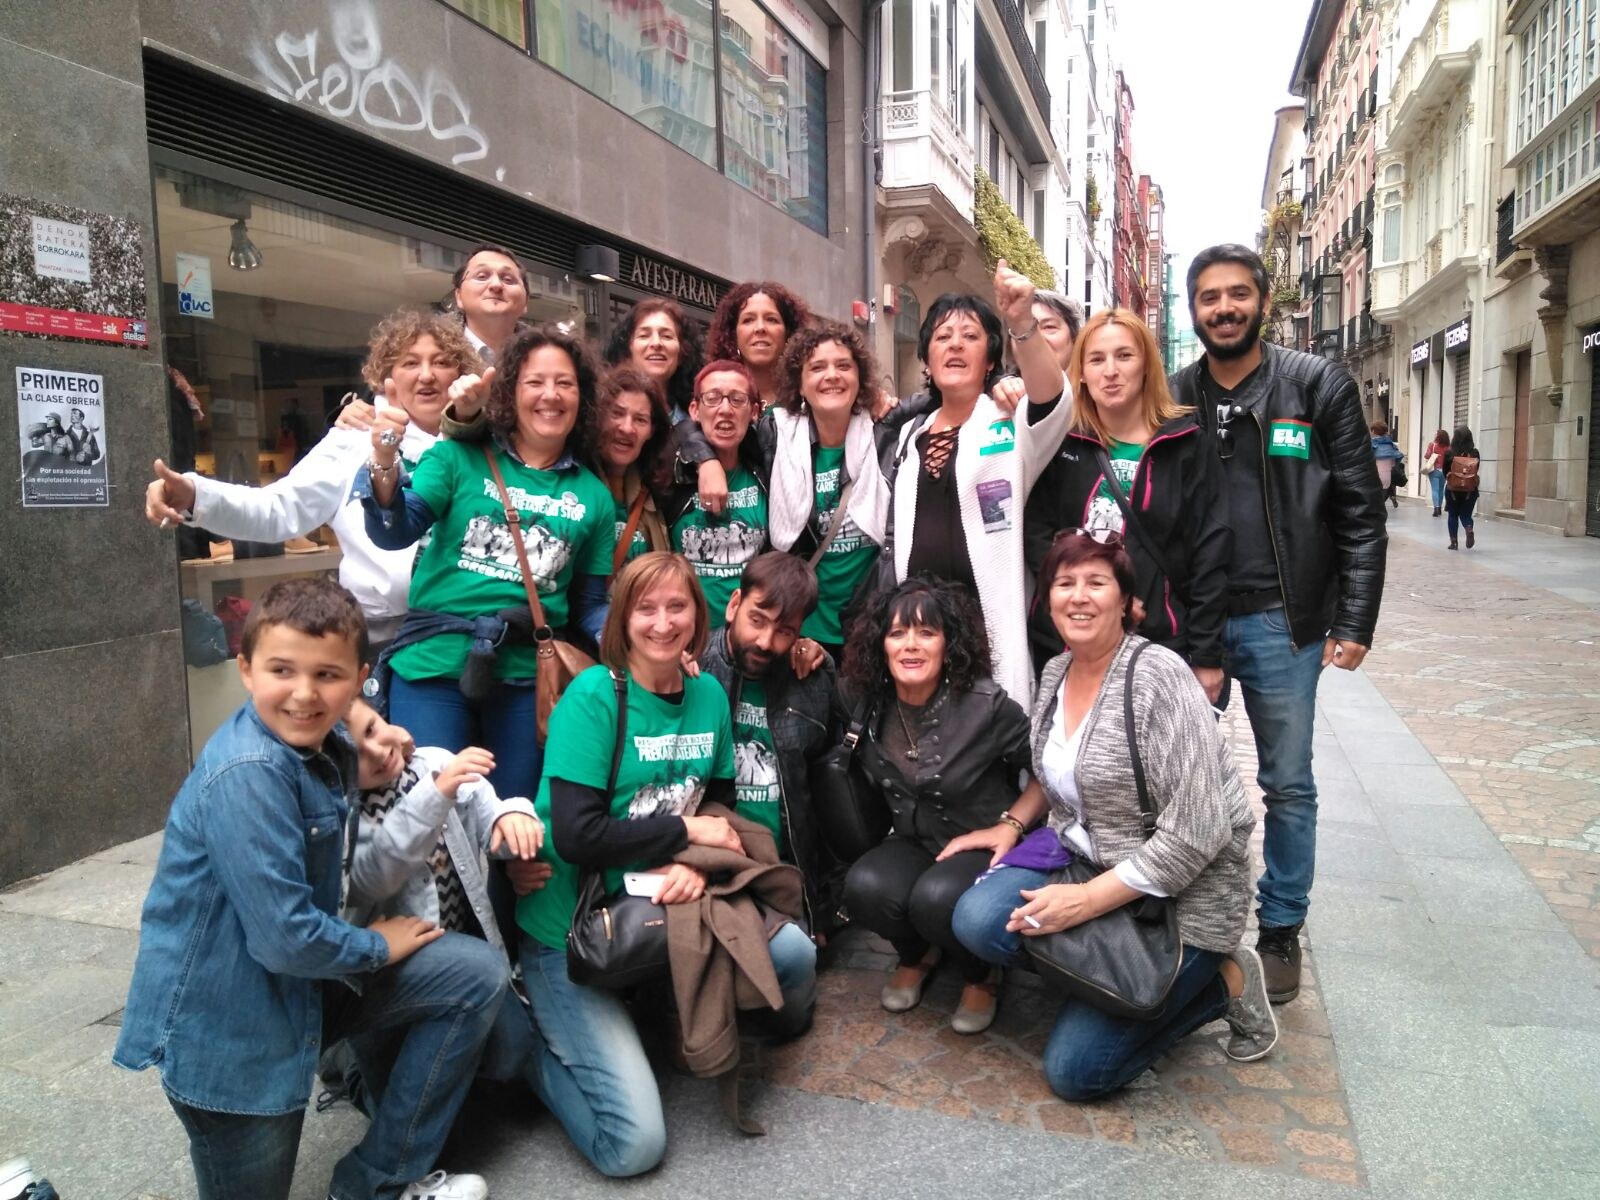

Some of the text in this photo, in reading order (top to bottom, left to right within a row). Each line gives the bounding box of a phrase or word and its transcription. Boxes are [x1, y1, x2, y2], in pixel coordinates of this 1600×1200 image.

[36, 223, 84, 240] DENOK
[36, 233, 85, 249] BATERA
[37, 244, 85, 260] BORROKARA
[631, 255, 718, 308] AYESTARAN
[21, 372, 99, 394] PRIMERO
[21, 393, 101, 407] LA CLASE OBRERA
[1273, 428, 1306, 446] ELA
